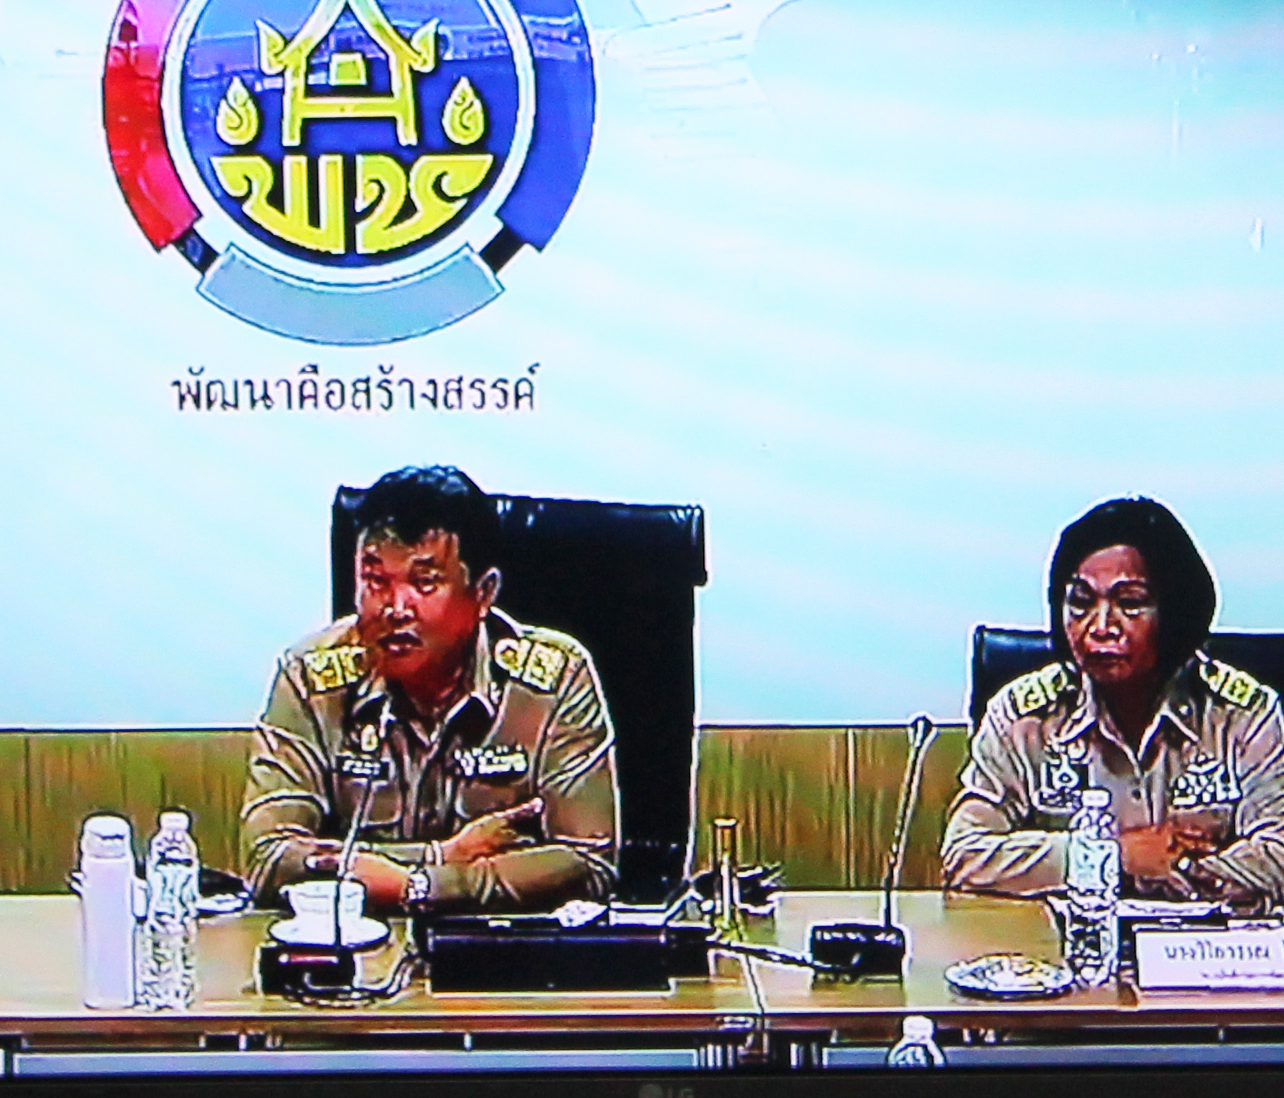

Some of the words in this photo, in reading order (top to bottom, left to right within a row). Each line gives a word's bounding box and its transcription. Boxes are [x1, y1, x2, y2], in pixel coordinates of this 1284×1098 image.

[170, 362, 541, 413] พัฒนาคือสร้างสรรค์
